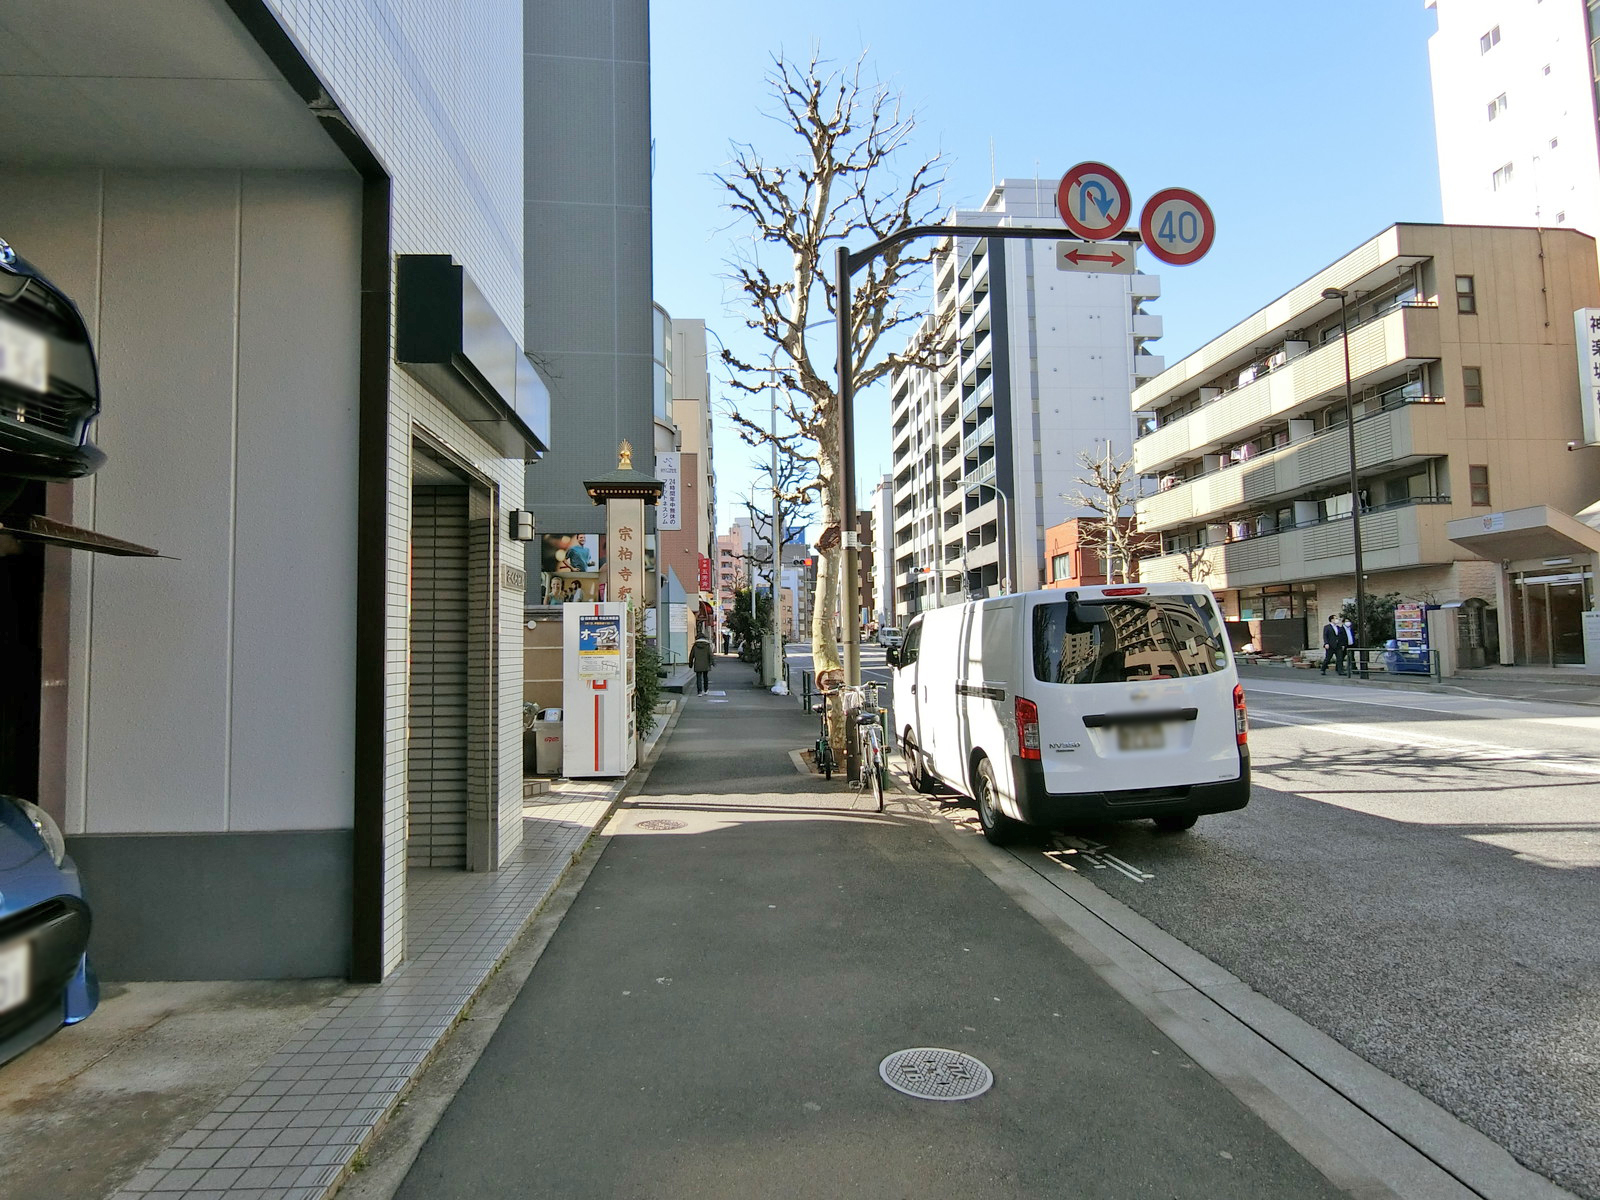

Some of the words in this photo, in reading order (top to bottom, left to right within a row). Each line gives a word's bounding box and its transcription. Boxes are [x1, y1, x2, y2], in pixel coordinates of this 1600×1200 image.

[1158, 210, 1198, 244] 40
[580, 628, 619, 641] オープン
